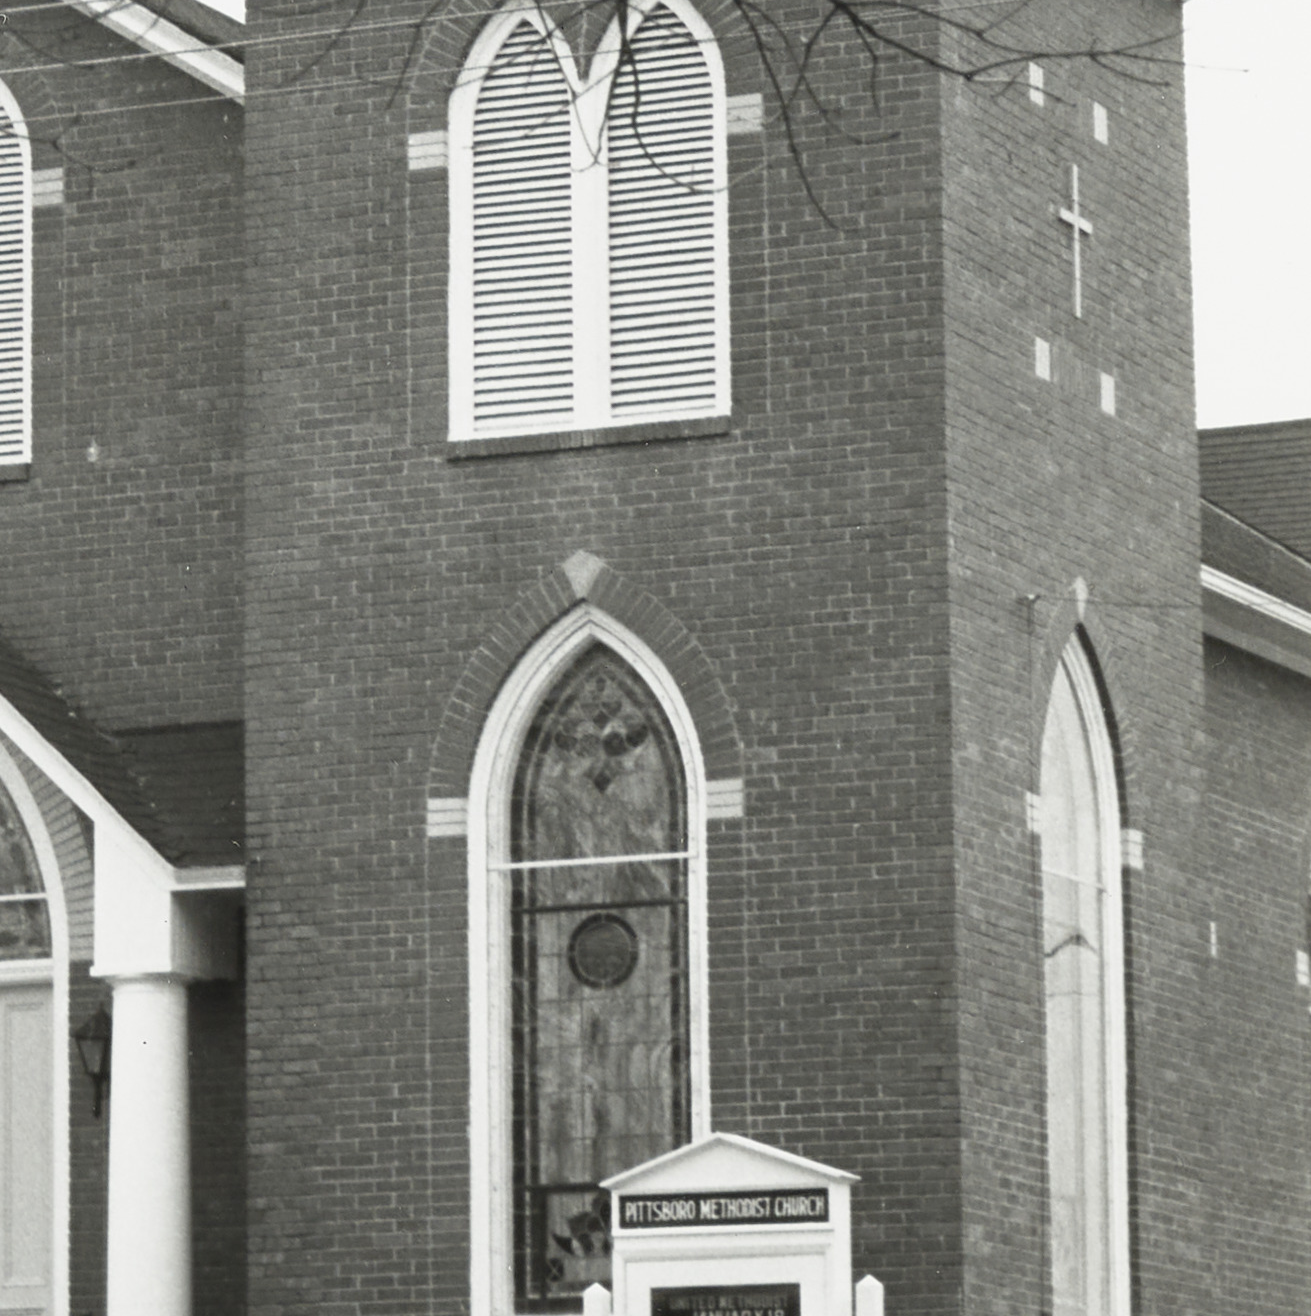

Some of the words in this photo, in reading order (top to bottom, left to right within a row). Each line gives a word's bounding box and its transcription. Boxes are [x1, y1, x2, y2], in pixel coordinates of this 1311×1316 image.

[625, 1200, 695, 1222] PITTSBORO
[700, 1198, 771, 1220] METHODIST
[774, 1195, 825, 1217] CHURCH
